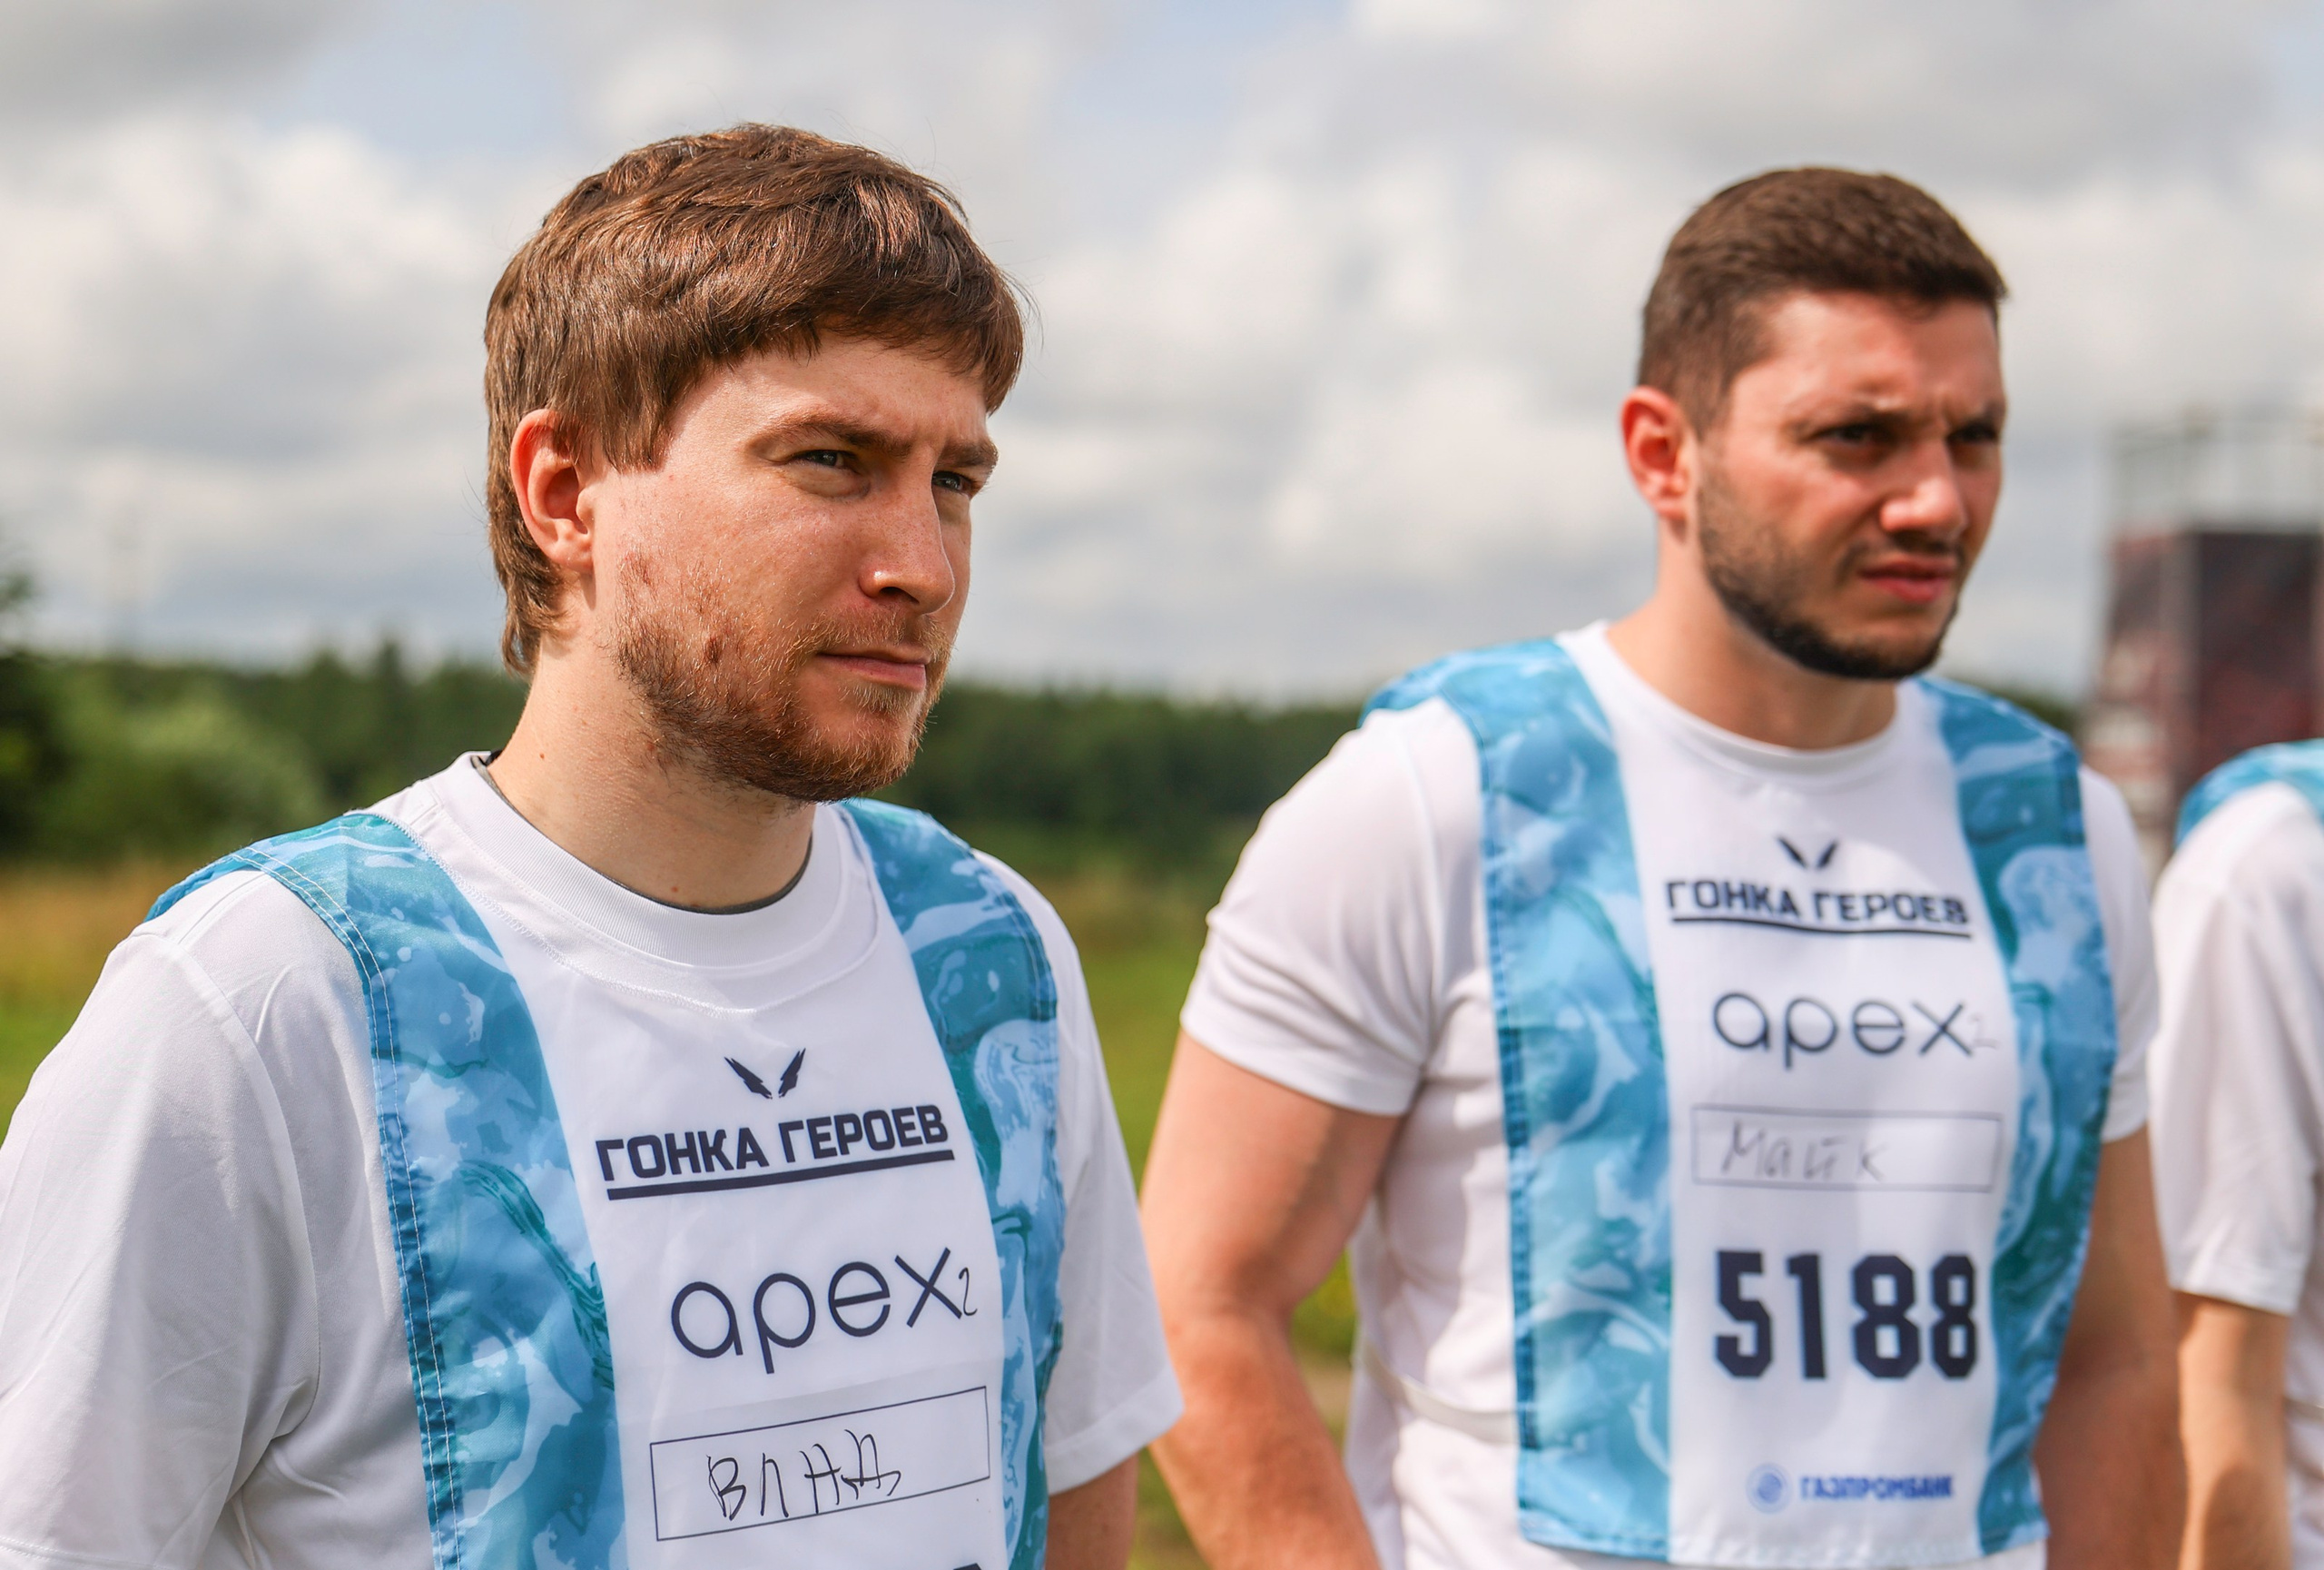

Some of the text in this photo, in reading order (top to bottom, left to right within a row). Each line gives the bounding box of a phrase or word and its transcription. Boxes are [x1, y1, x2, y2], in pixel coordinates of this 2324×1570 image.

[1665, 880, 1970, 925] ГОНКА ГЕРОЕВ
[1713, 992, 1973, 1072] apex
[596, 1104, 950, 1181] ГОНКА ГЕРОЕВ
[670, 1247, 963, 1375] apex
[1714, 1249, 1978, 1380] 5188
